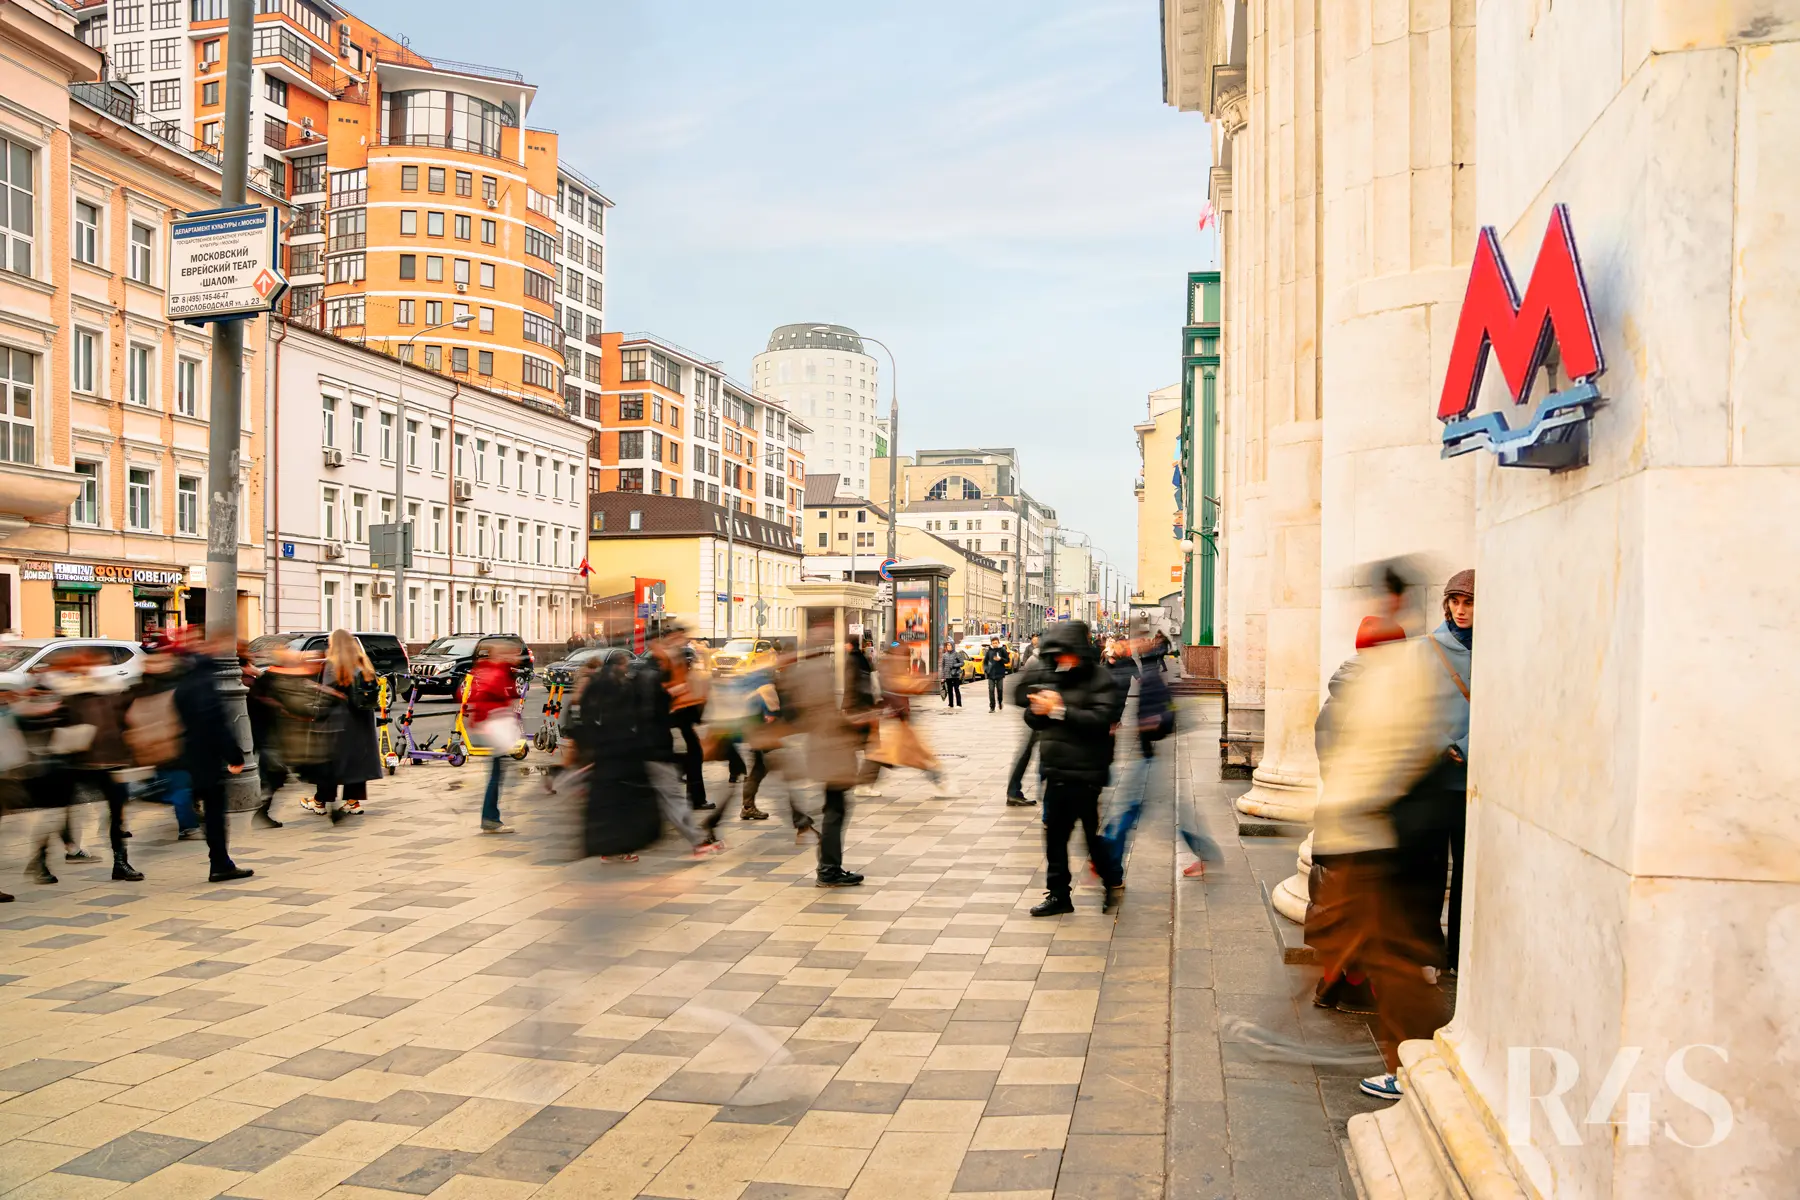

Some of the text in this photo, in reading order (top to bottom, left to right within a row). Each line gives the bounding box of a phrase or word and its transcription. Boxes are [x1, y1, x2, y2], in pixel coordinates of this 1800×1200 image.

[174, 225, 211, 236] ДЕПАРТАМЕНТ
[211, 221, 238, 231] КУЛЬТУРЫ
[190, 245, 249, 263] МОСКОВСКИЙ
[181, 260, 258, 277] ЕВРЕЙСКИЙ ТЕАТР
[171, 300, 234, 313] НОВОСЛОБОДСКАЯ
[250, 297, 260, 305] 23
[181, 292, 229, 304] 8 (495) 745-46-47
[24, 570, 54, 580] ДОМ БЫТА
[95, 565, 133, 578] ФОТО
[133, 569, 183, 584] ЮВЕЛИР
[61, 612, 80, 620] ФОТО
